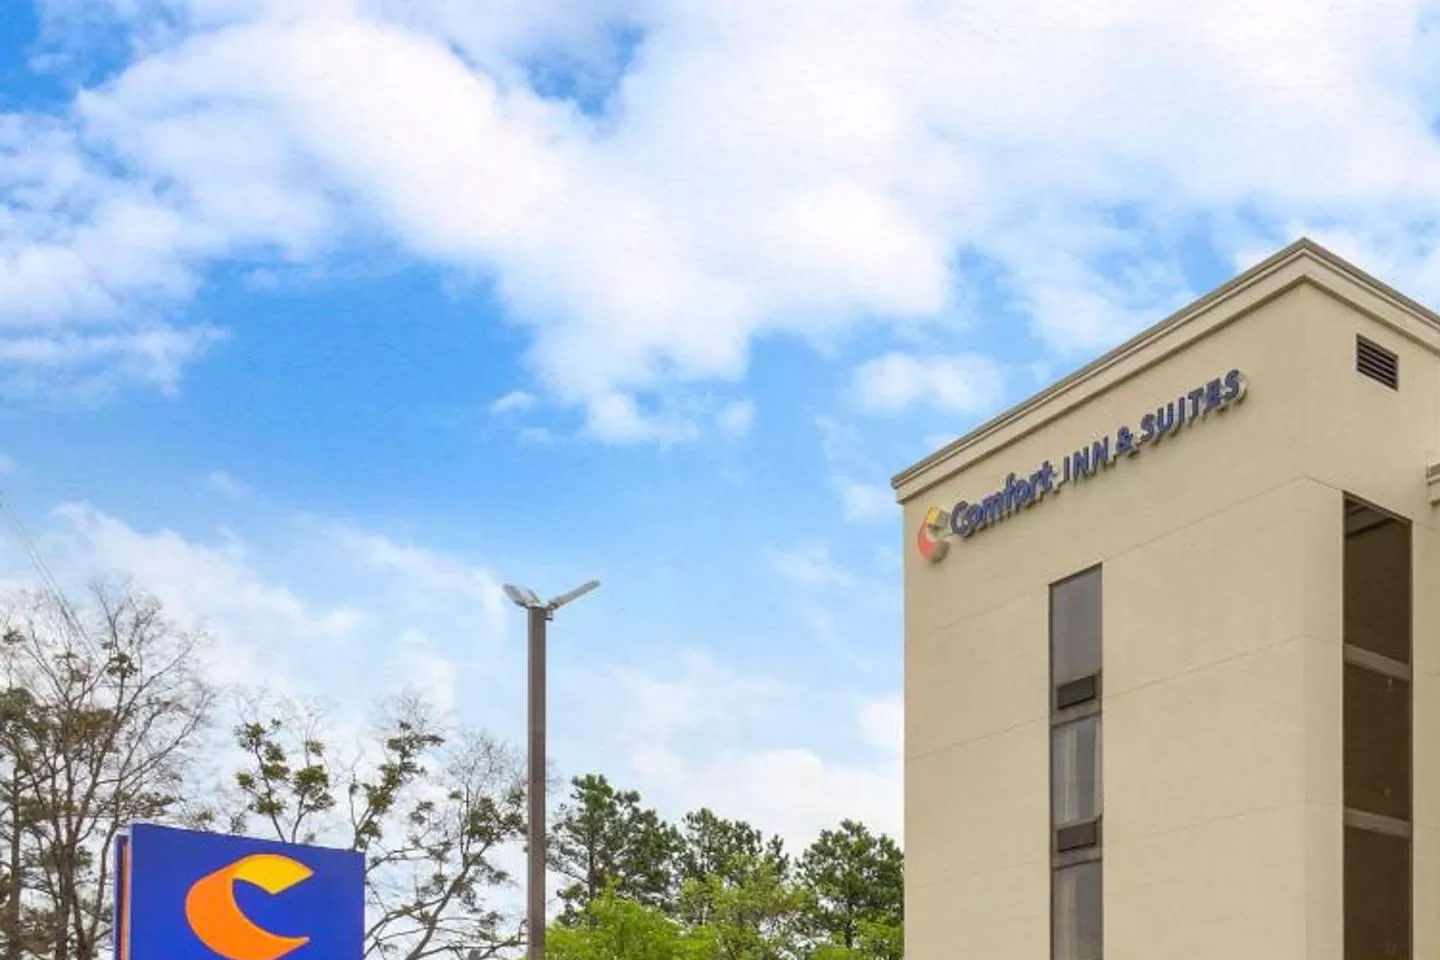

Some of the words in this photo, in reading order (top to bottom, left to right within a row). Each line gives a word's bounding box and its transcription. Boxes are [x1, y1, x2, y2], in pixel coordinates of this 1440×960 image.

[951, 460, 1054, 537] Comfort
[1063, 435, 1111, 482] INN
[1116, 426, 1135, 456] &
[1140, 369, 1243, 443] SUITES
